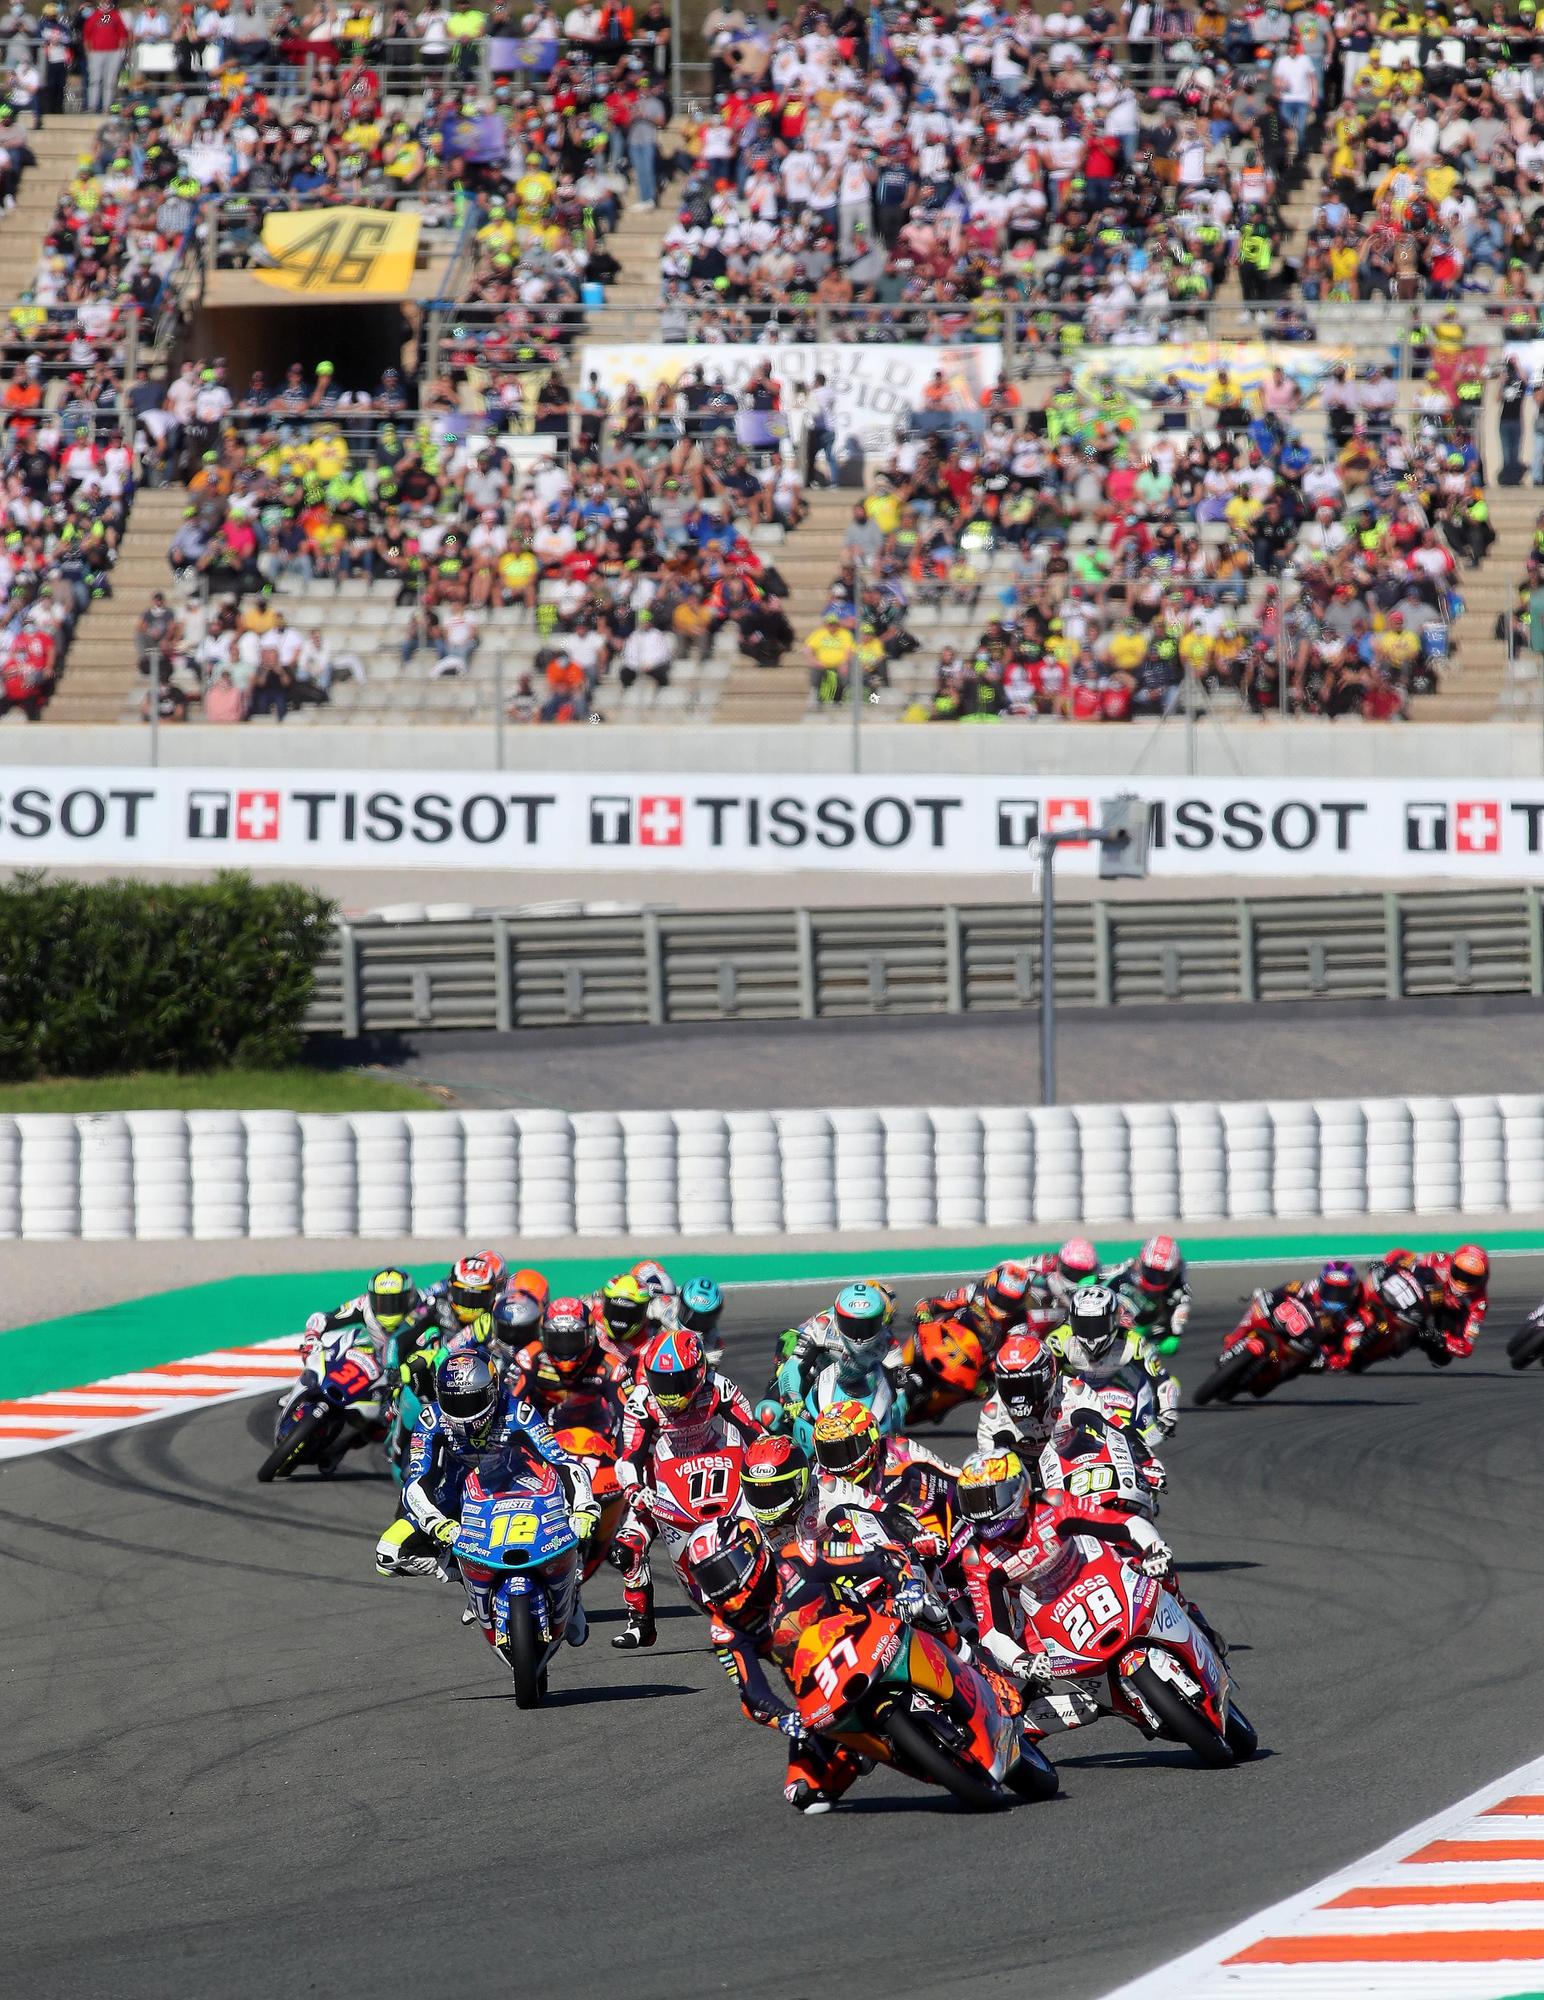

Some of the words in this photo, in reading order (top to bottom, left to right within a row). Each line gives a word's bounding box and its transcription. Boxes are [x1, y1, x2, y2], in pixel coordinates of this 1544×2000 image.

[266, 213, 393, 290] 46
[0, 789, 154, 838] SOT
[291, 792, 556, 843] TISSOT
[695, 796, 962, 847] TISSOT
[328, 1362, 370, 1396] 31
[674, 1454, 734, 1479] valresa
[687, 1467, 729, 1503] 11
[751, 1465, 776, 1477] Arai
[1069, 1466, 1114, 1497] 20
[489, 1513, 540, 1550] 12
[1050, 1573, 1110, 1624] valresa
[1062, 1584, 1124, 1653] 28
[813, 1634, 859, 1702] 37
